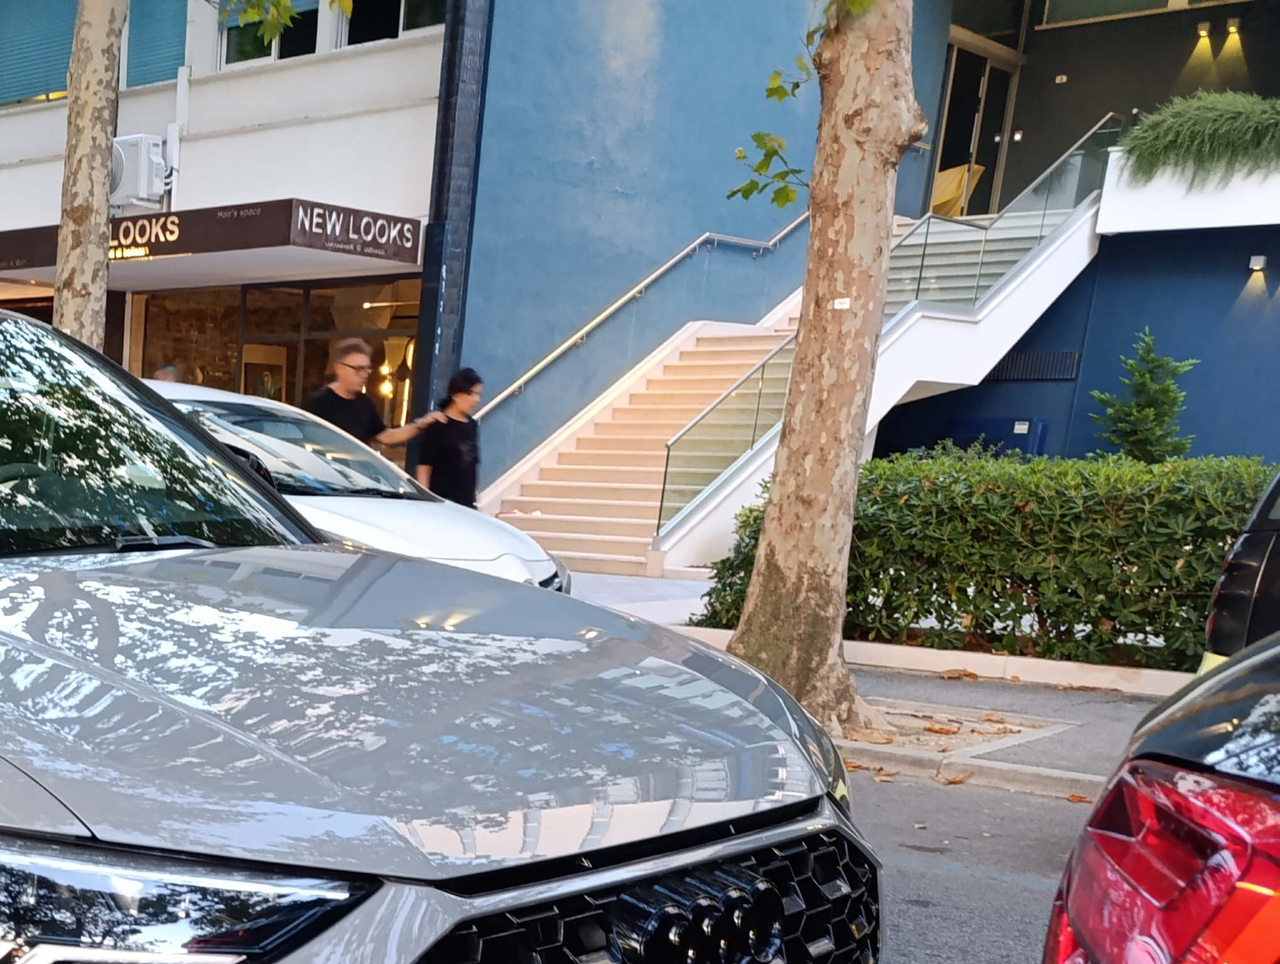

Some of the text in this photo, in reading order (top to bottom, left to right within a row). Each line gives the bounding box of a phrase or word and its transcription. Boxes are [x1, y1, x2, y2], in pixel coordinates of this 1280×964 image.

[109, 215, 180, 246] LOOKS
[298, 205, 343, 236] NEW
[349, 213, 413, 248] LOOKS
